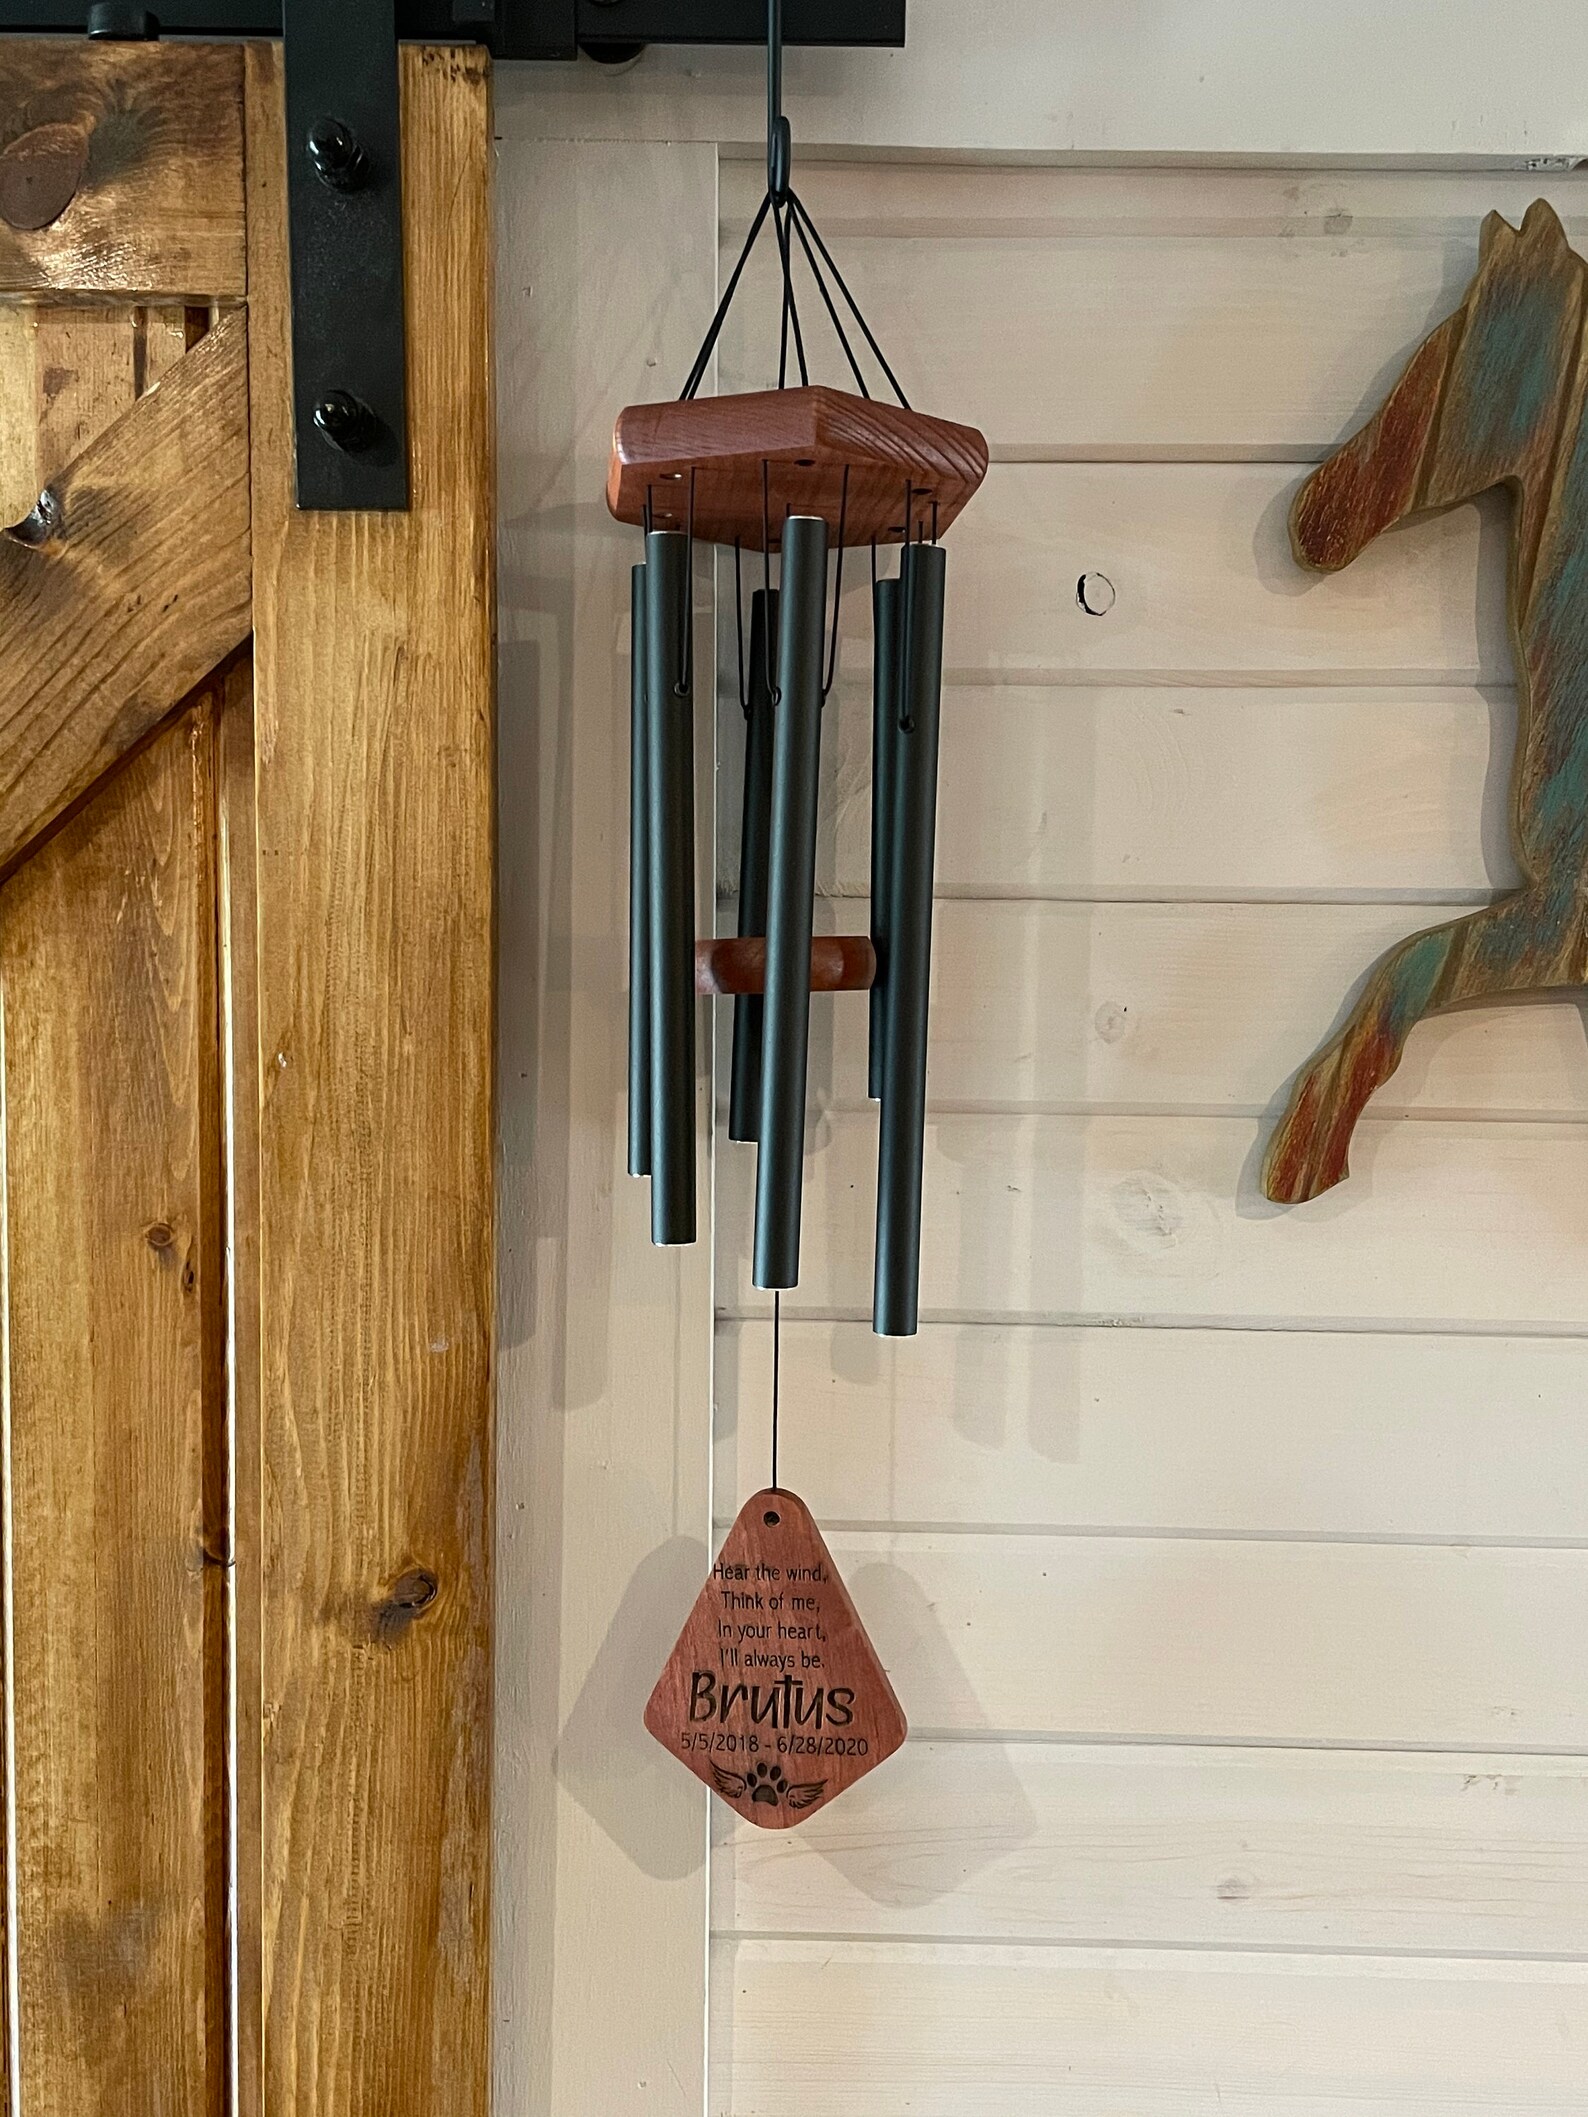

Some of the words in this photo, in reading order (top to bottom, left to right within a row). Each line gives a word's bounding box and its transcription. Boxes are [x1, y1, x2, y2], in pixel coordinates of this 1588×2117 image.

[713, 1562, 750, 1581] Hear
[756, 1563, 780, 1581] the
[786, 1562, 829, 1584] wind,
[721, 1591, 764, 1610] Think
[769, 1591, 785, 1610] of
[791, 1596, 820, 1614] me,
[718, 1619, 732, 1638] In
[738, 1624, 772, 1645] your
[777, 1621, 826, 1642] heart,
[721, 1648, 738, 1667] I'll
[744, 1649, 796, 1672] always
[689, 1671, 855, 1729] Brutus
[681, 1732, 760, 1753] 5/5/2018
[777, 1735, 869, 1756] 6/28/2020
